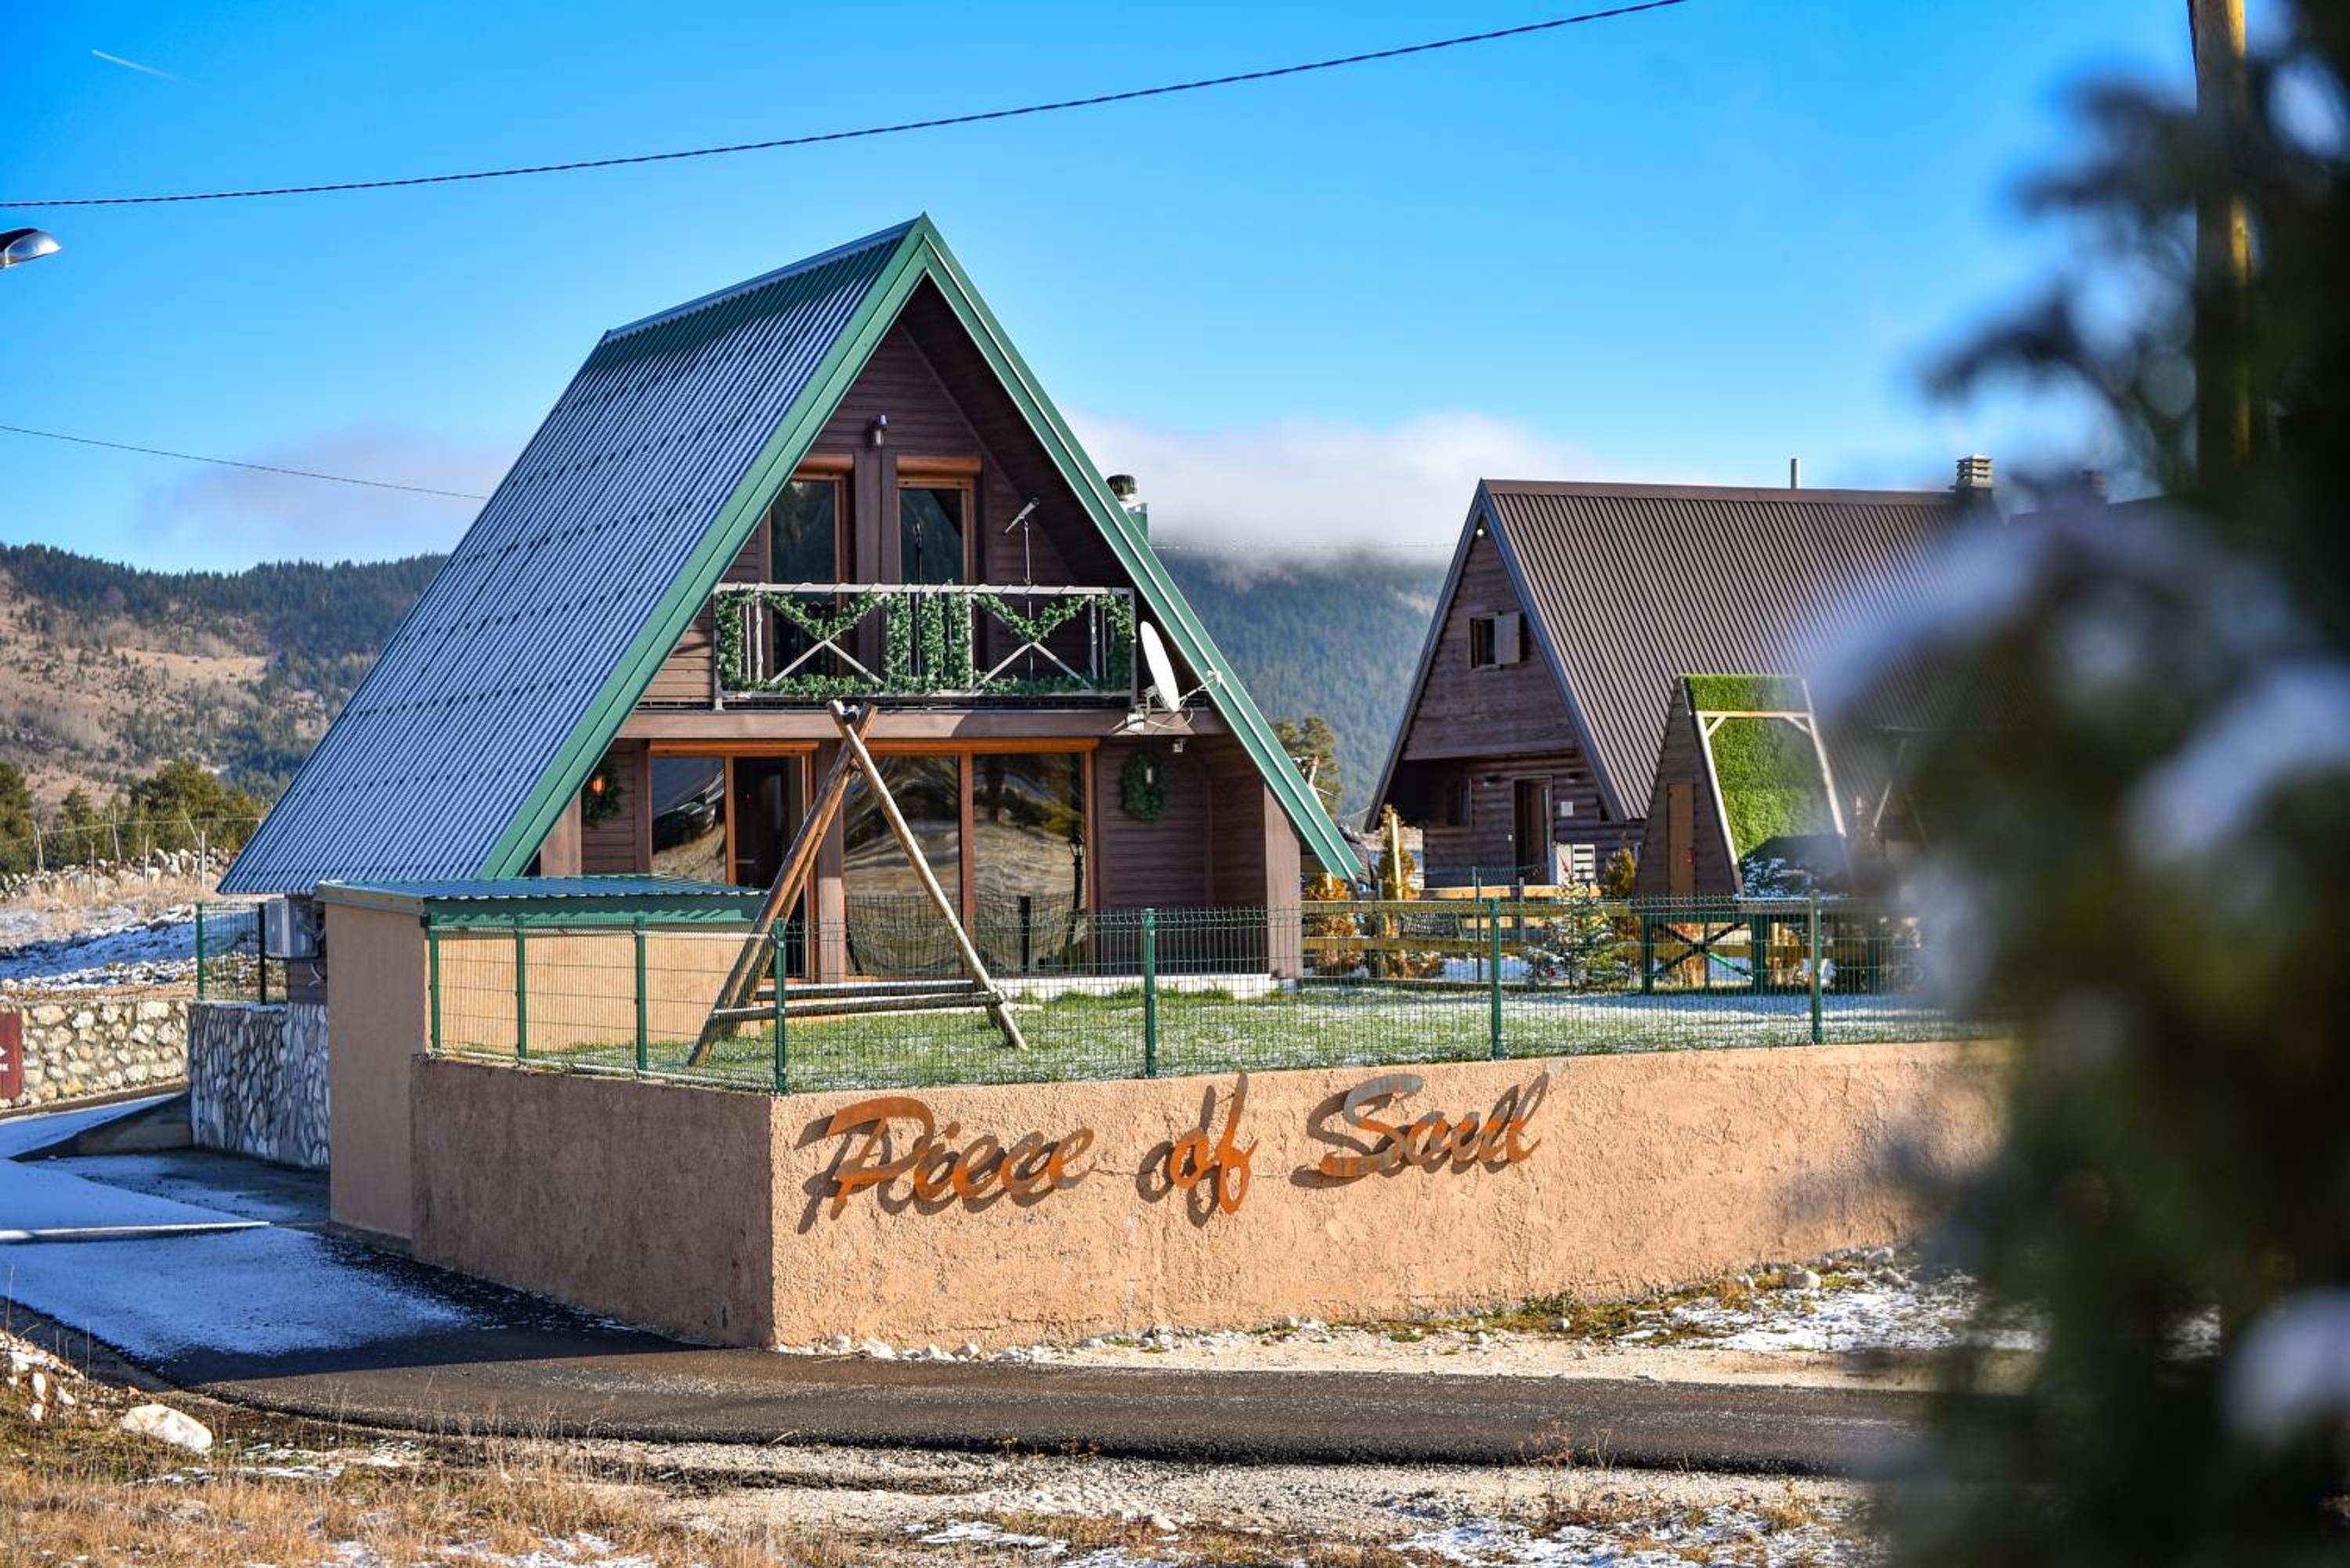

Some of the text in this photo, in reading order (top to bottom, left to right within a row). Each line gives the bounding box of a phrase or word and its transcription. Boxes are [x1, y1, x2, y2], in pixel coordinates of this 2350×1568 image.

[826, 1071, 1550, 1221] Piece of Soul
